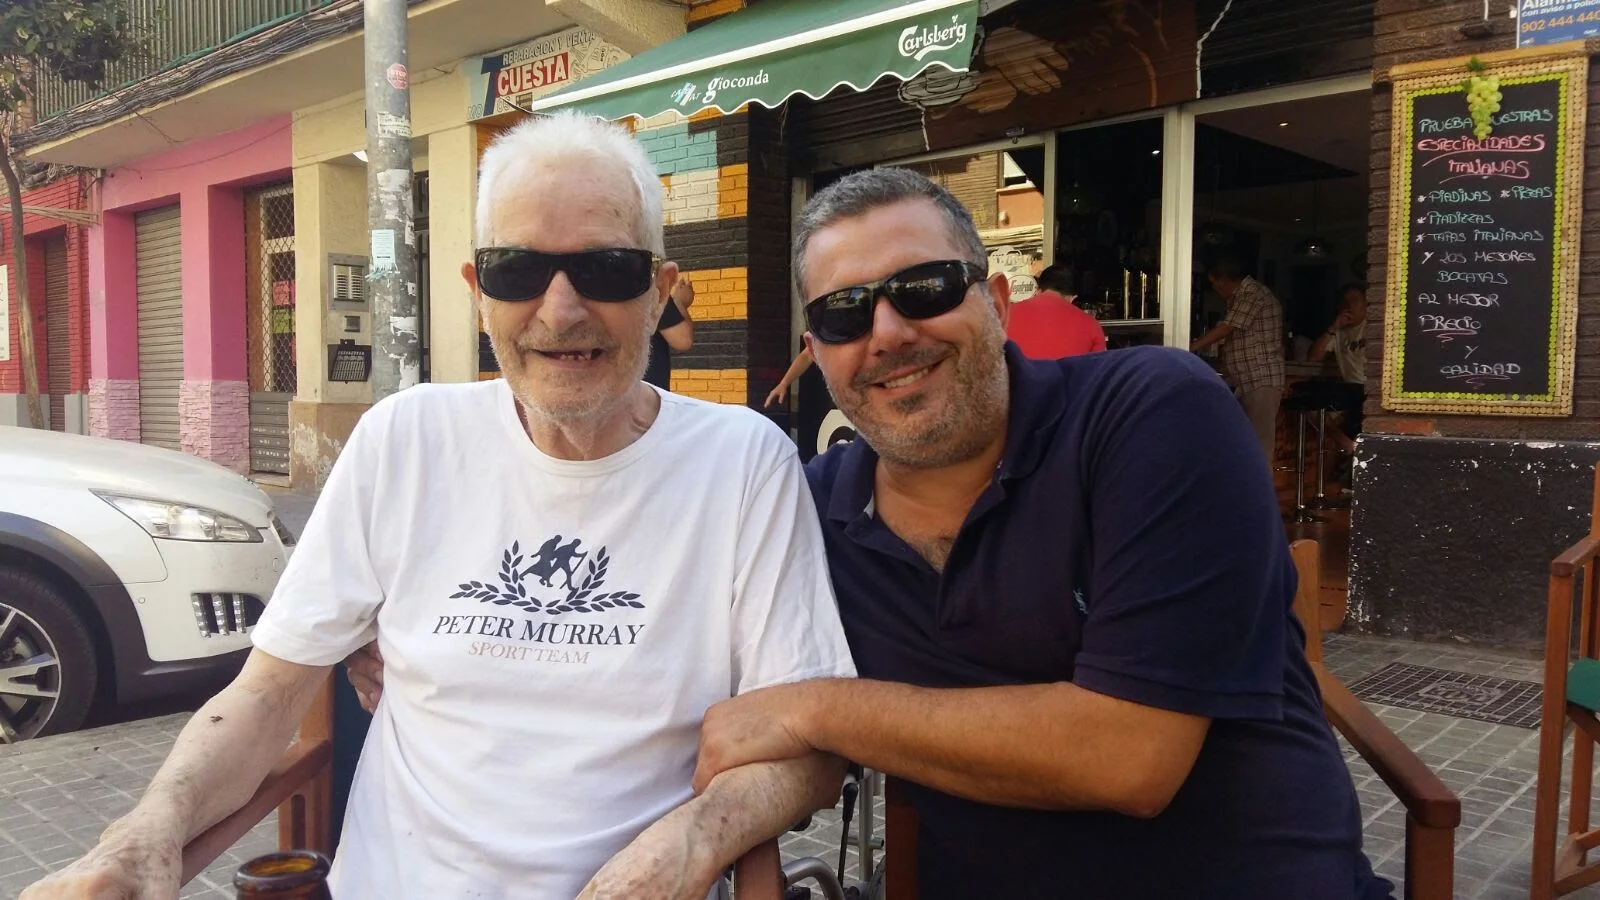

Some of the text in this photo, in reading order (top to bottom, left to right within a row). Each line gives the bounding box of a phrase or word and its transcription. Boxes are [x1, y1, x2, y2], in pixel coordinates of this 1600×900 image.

[1521, 9, 1539, 17] con
[1540, 5, 1565, 14] aviso
[1521, 19, 1546, 33] 902
[1548, 15, 1574, 28] 444
[566, 31, 595, 47] VENTA
[898, 20, 967, 59] Carlsberg
[497, 55, 567, 96] CUESTA
[702, 69, 769, 104] gioconda
[1419, 109, 1553, 133] PRUEBA UESTRAS
[1417, 133, 1546, 152] ESPECIALIDADES
[1421, 251, 1435, 264] Y
[1474, 249, 1537, 263] MEJORES
[1437, 270, 1508, 285] BOCATAS
[1418, 292, 1500, 307] AL MEJOR
[1464, 345, 1480, 359] Y
[432, 615, 647, 646] PETER MURRAY
[468, 641, 590, 665] SPORT TEAM
